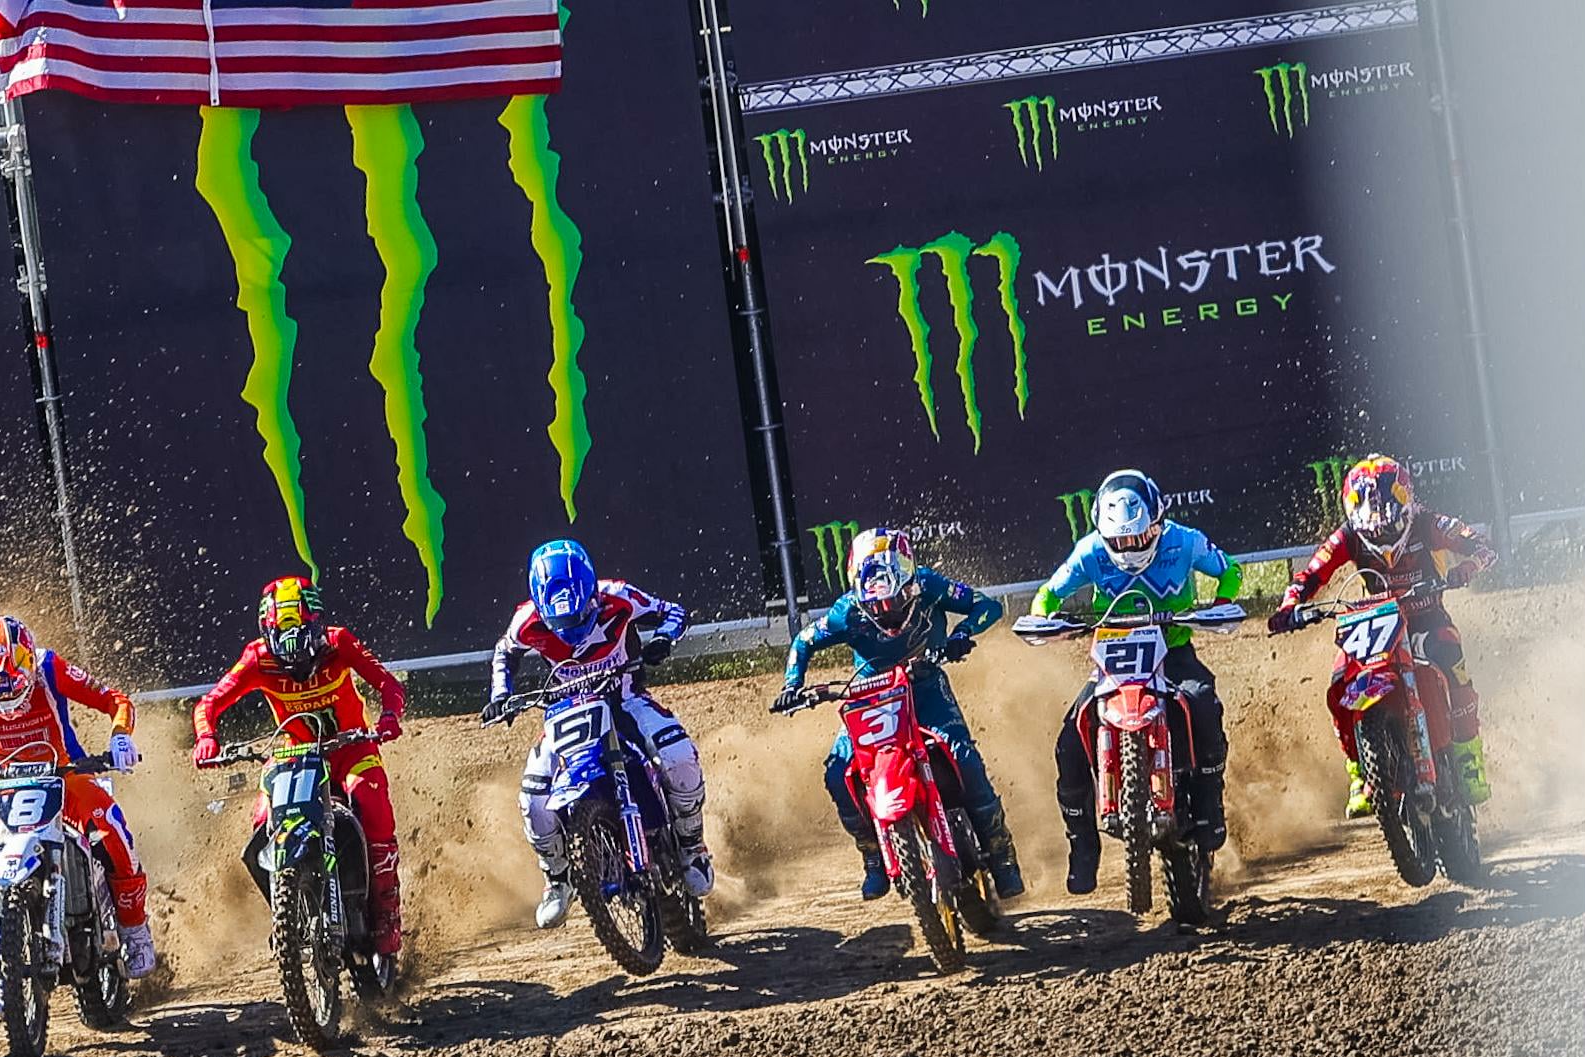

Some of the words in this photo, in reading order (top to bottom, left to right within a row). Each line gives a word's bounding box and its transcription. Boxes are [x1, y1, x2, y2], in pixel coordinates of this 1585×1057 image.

[1311, 62, 1414, 91] MONSTER
[1059, 95, 1162, 124] MONSTER
[1076, 115, 1150, 131] ENERGY
[809, 128, 912, 157] MONSTER
[826, 148, 899, 165] ENERGY
[1032, 234, 1336, 308] MONSTER
[1086, 292, 1294, 336] ENERGY
[1342, 613, 1399, 660] 47
[1104, 641, 1157, 675] 21
[271, 768, 317, 809] 11
[7, 789, 48, 827] 8
